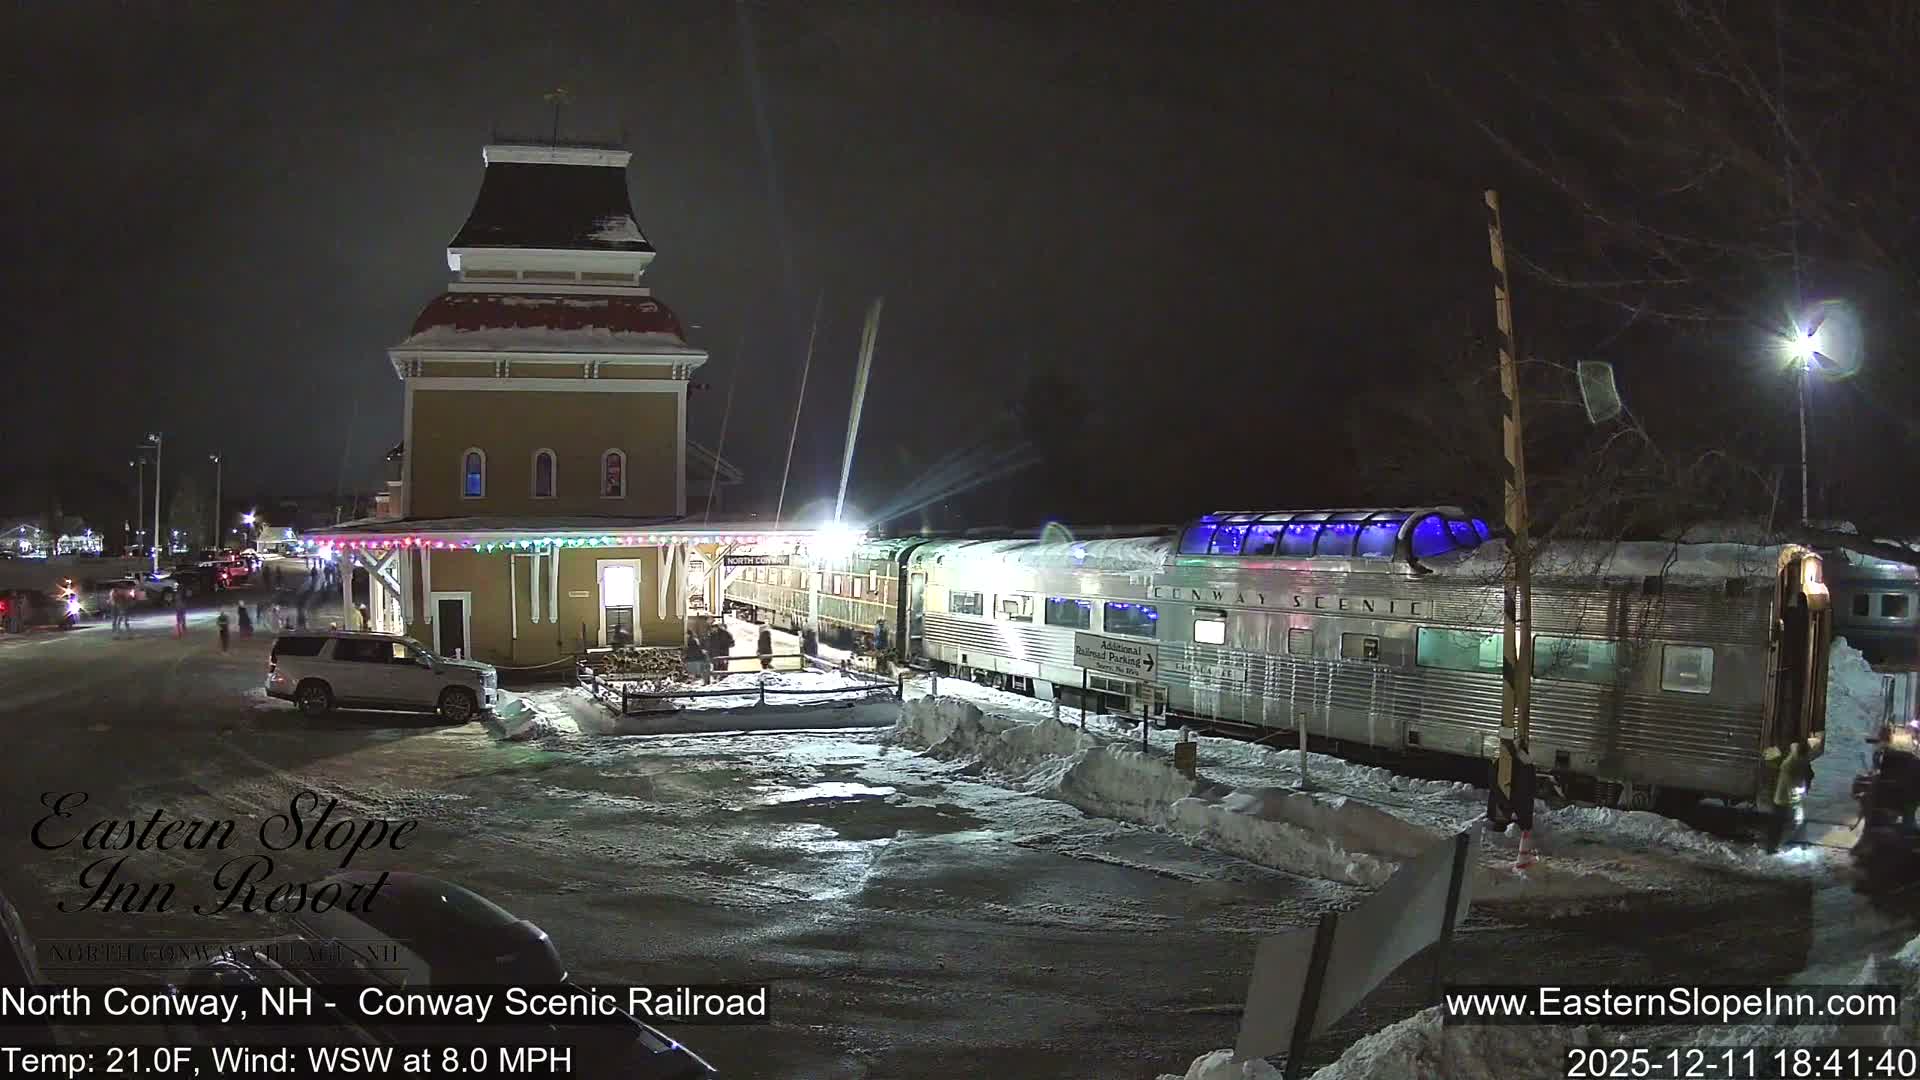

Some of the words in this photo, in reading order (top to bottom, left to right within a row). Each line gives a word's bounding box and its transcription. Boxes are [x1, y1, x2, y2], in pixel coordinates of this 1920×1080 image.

[727, 556, 754, 565] NORTH
[755, 556, 787, 565] CONWAY
[1154, 587, 1265, 605] CONWAY
[1293, 595, 1421, 616] SCENIC
[1074, 645, 1106, 660] Railroad
[1108, 652, 1141, 669] Parking
[1100, 640, 1142, 656] Additional
